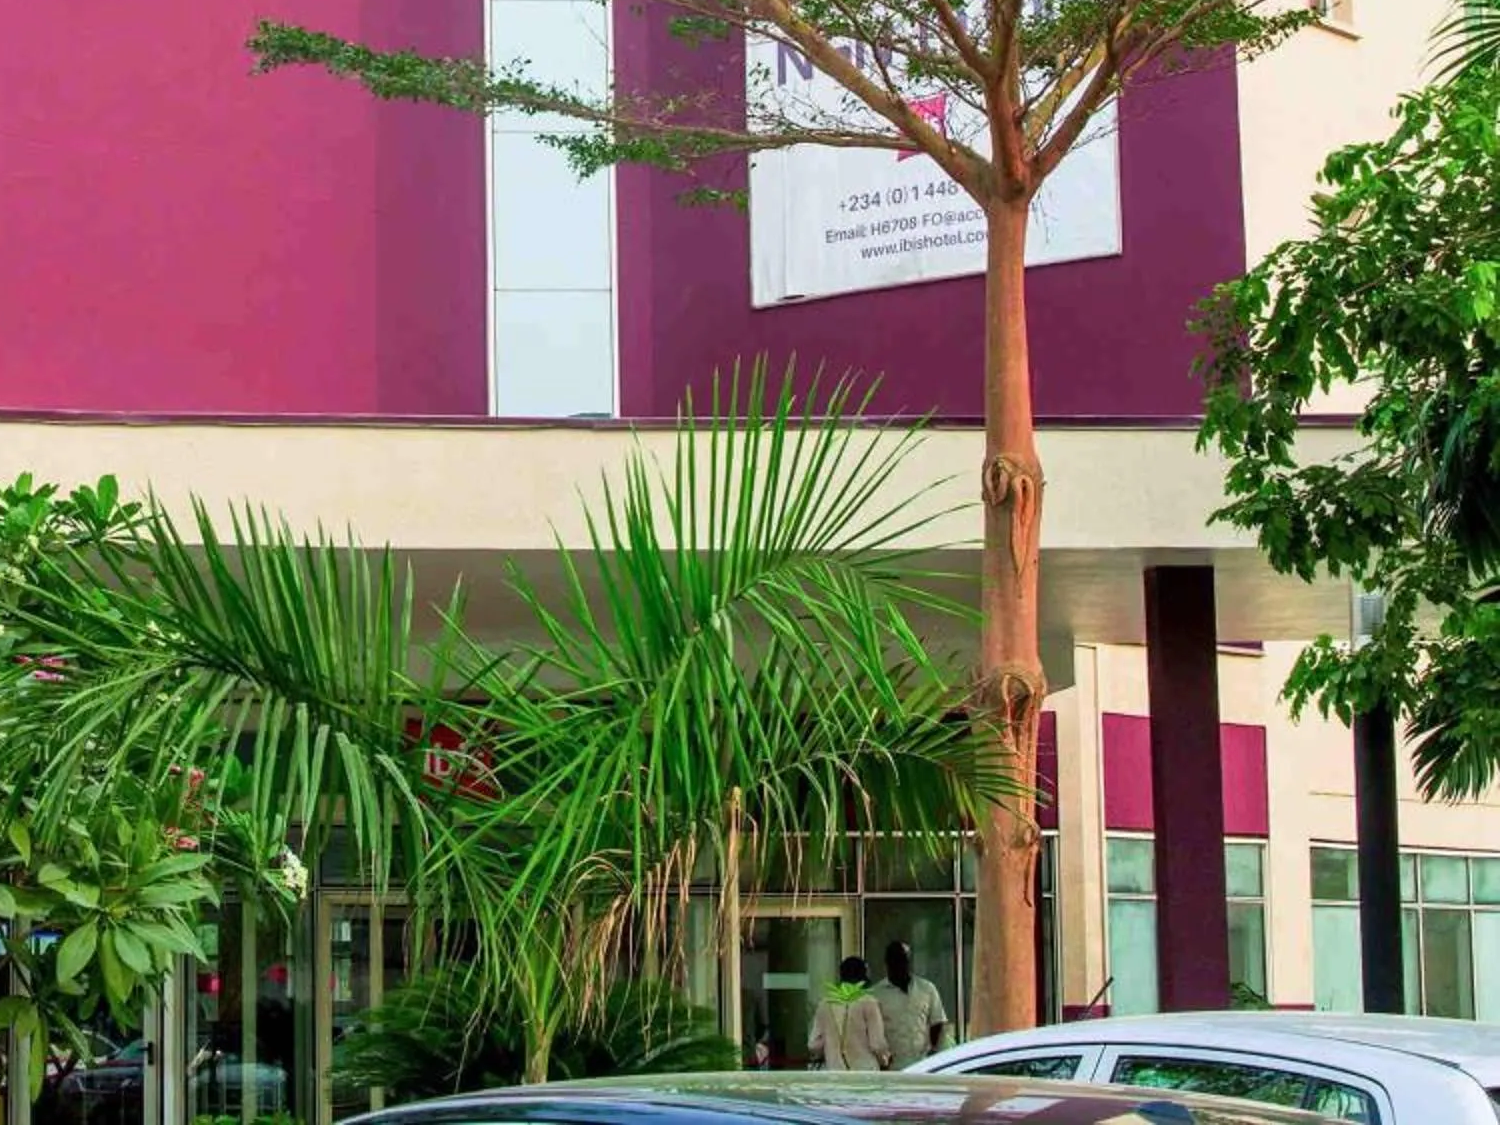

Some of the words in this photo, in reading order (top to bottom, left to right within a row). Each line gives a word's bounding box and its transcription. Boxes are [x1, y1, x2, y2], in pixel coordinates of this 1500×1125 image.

[839, 191, 881, 213] +234
[870, 216, 917, 236] H6708
[921, 209, 984, 228] FO@acc
[861, 229, 989, 259] www.ibishotel.co
